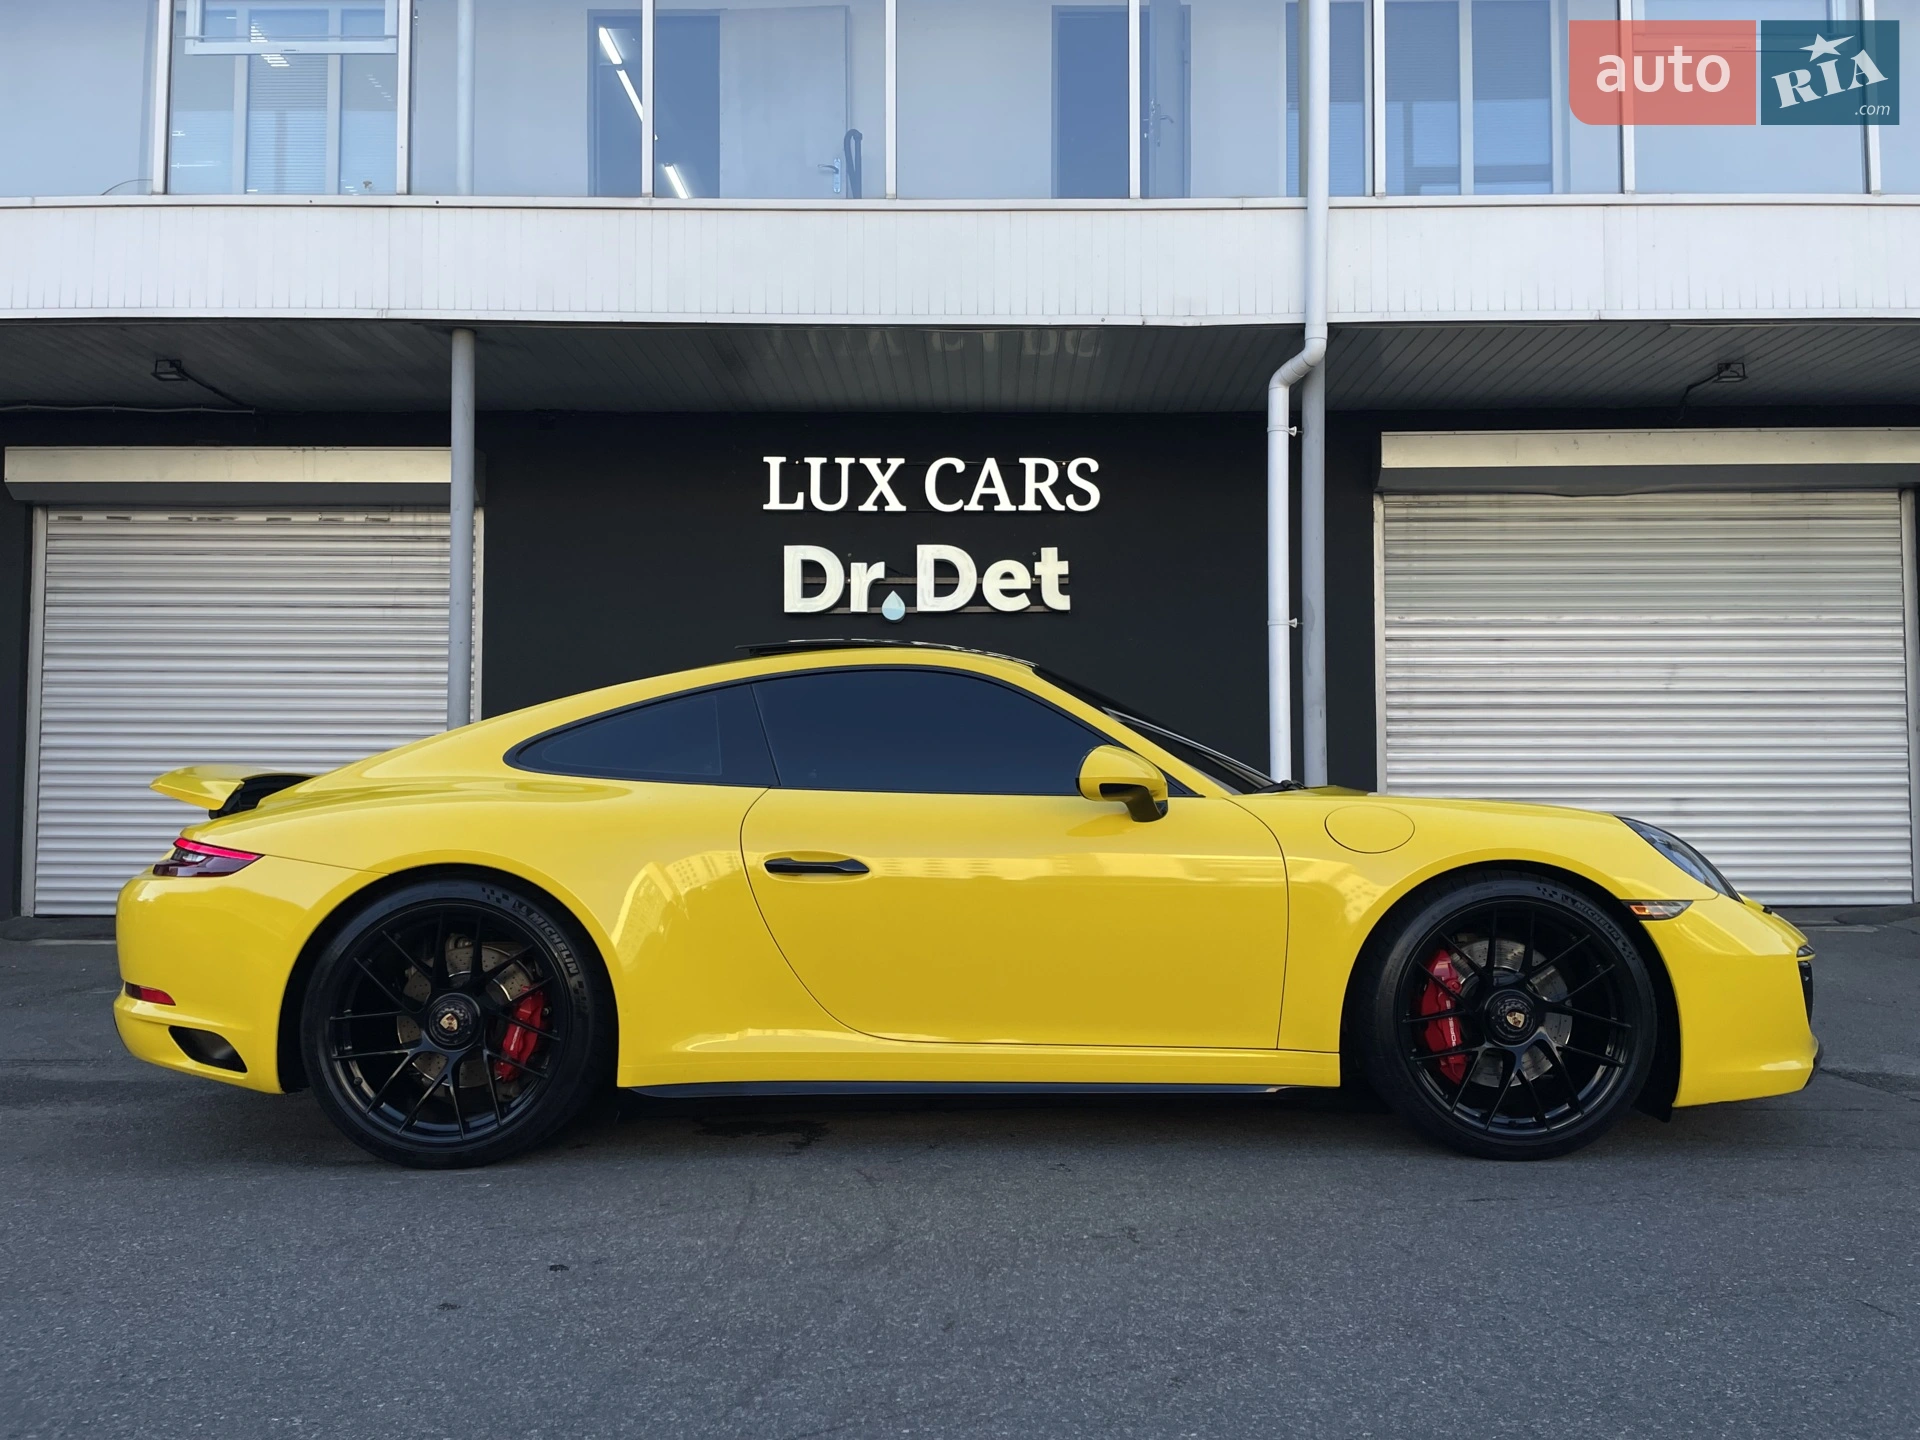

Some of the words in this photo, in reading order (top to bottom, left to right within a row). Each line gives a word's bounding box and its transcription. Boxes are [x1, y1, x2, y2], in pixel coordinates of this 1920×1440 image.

[762, 456, 907, 512] LUX
[924, 456, 1101, 512] CARS
[528, 912, 579, 975] MICHELIN
[1574, 902, 1621, 940] MICHELIN
